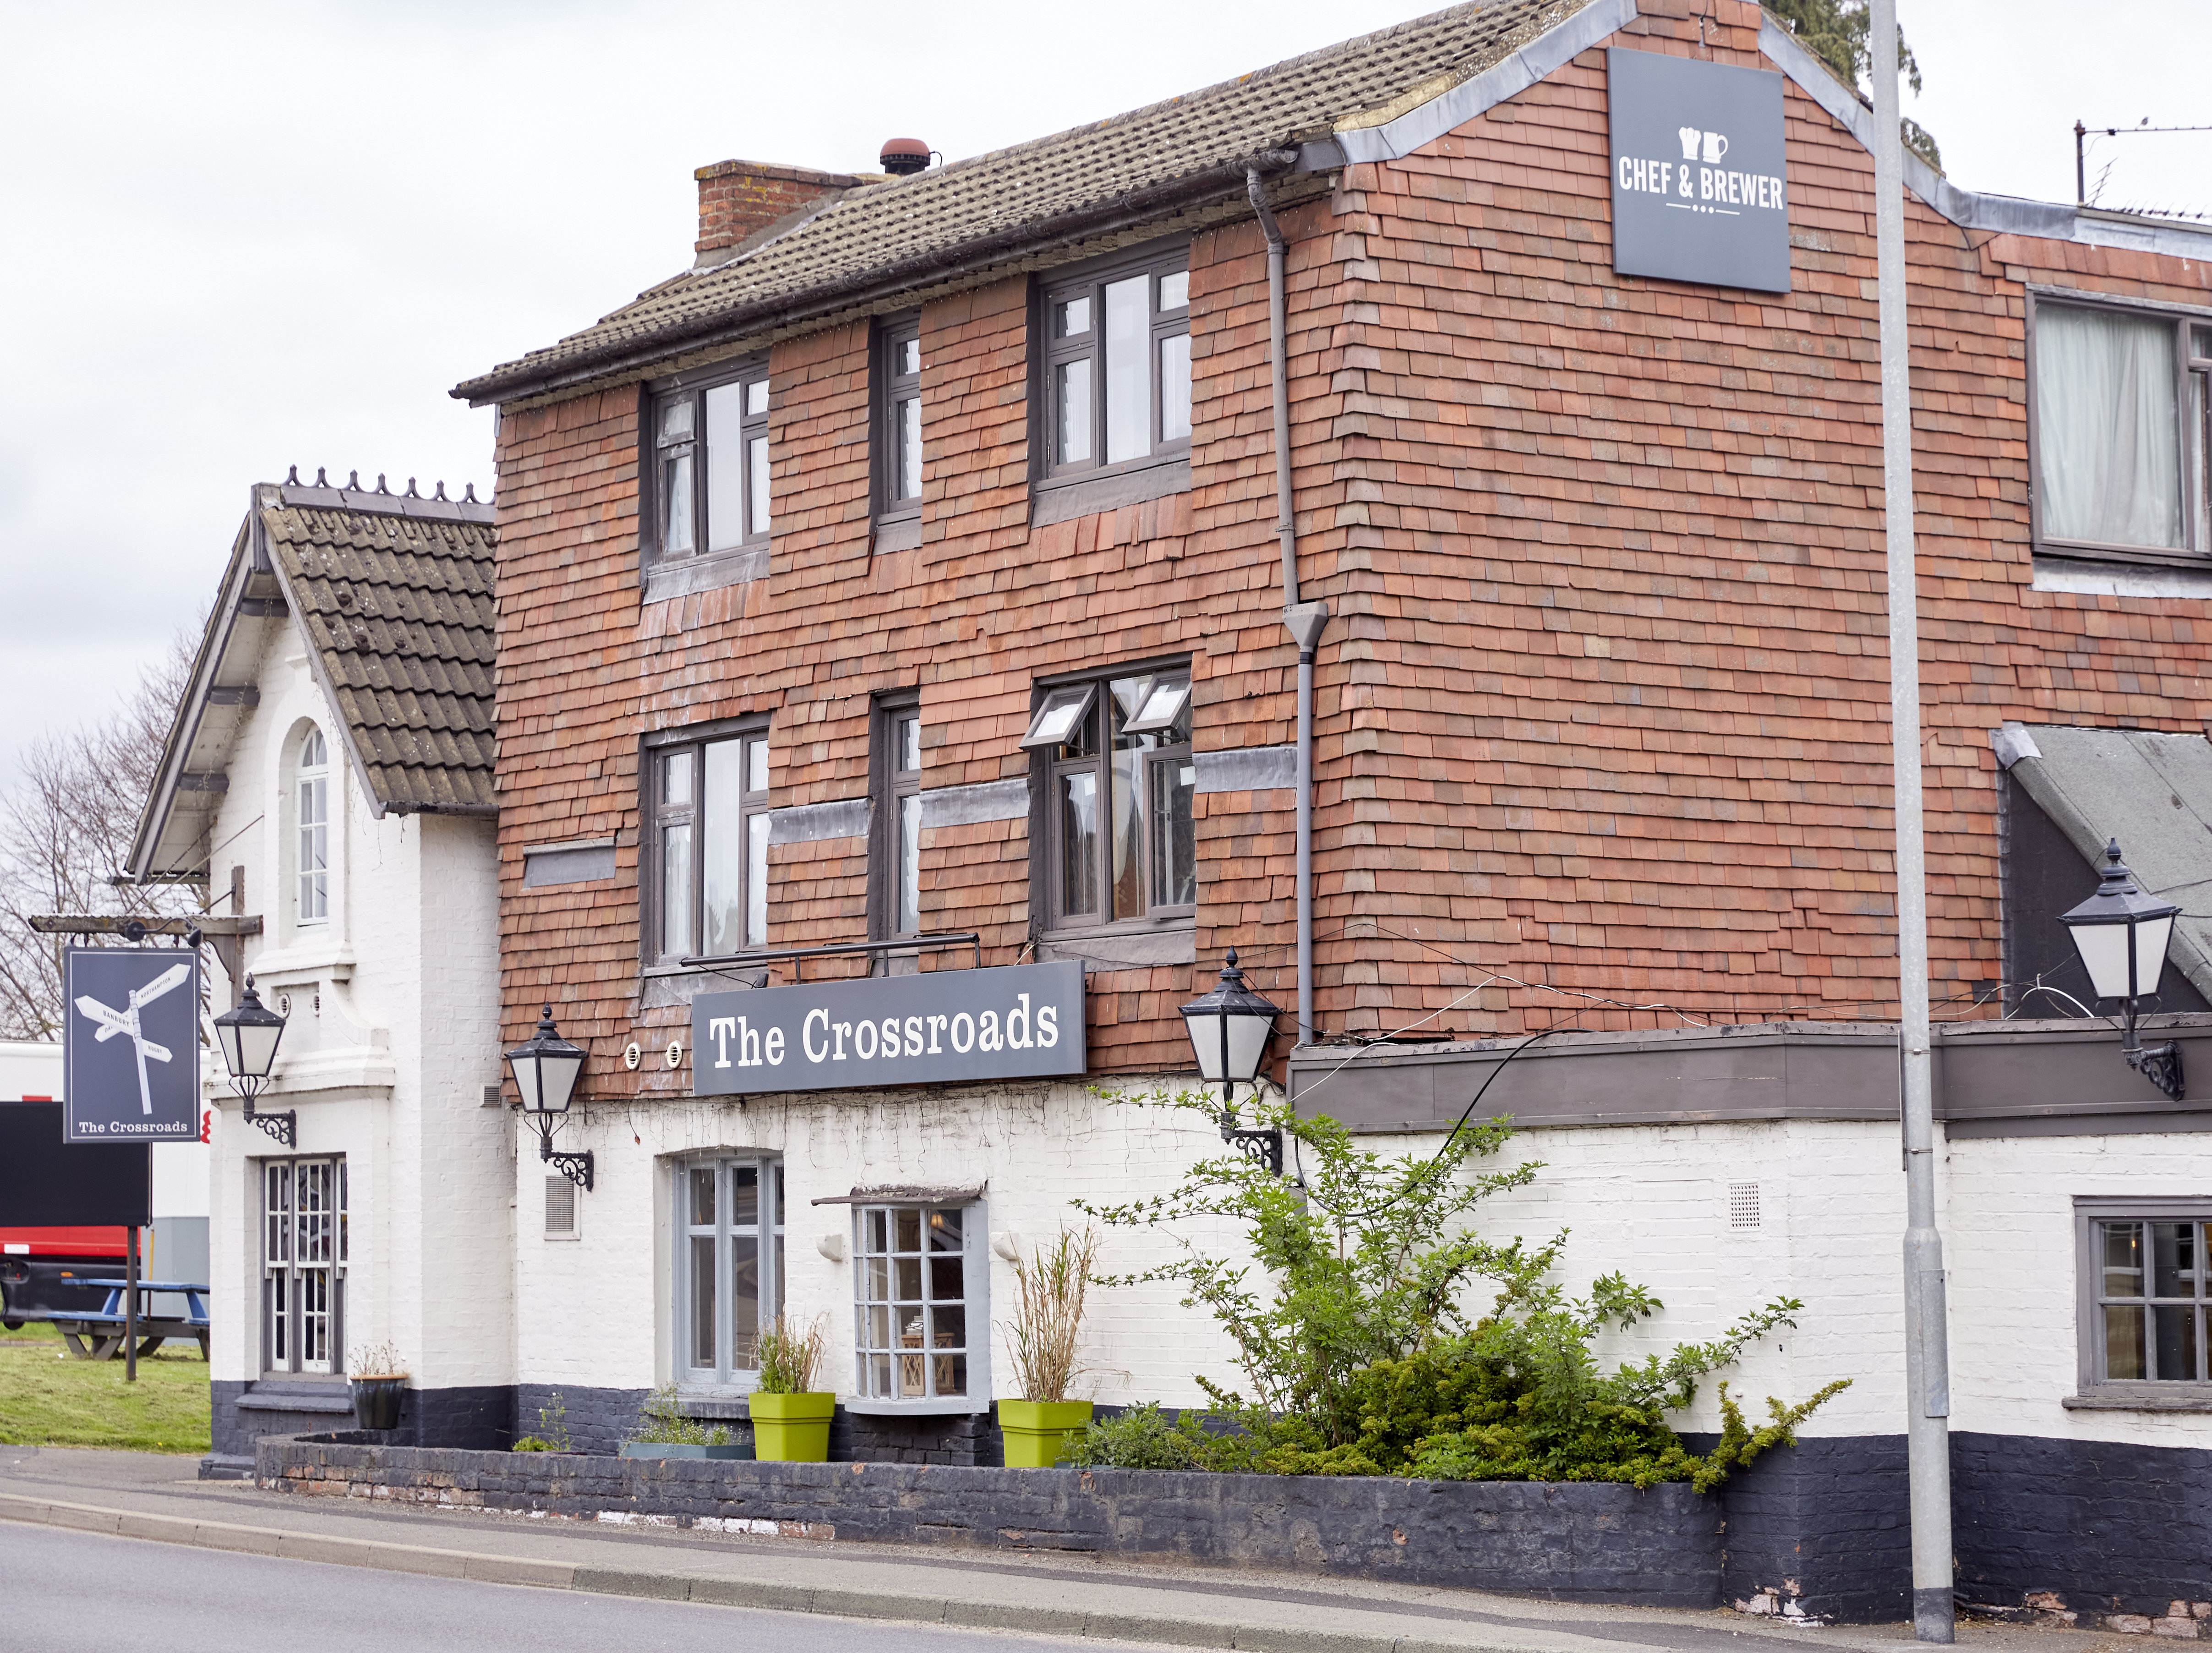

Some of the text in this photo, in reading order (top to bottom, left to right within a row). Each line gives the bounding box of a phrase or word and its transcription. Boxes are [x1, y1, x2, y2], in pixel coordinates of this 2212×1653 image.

[1619, 156, 1783, 210] CHEF & BREWER
[140, 976, 171, 999] NORTHAMPTON
[103, 1009, 129, 1027] BANBURY
[710, 993, 1059, 1068] The Crossroads
[147, 1044, 162, 1054] RUGBY
[78, 1121, 188, 1133] The Crossroads
